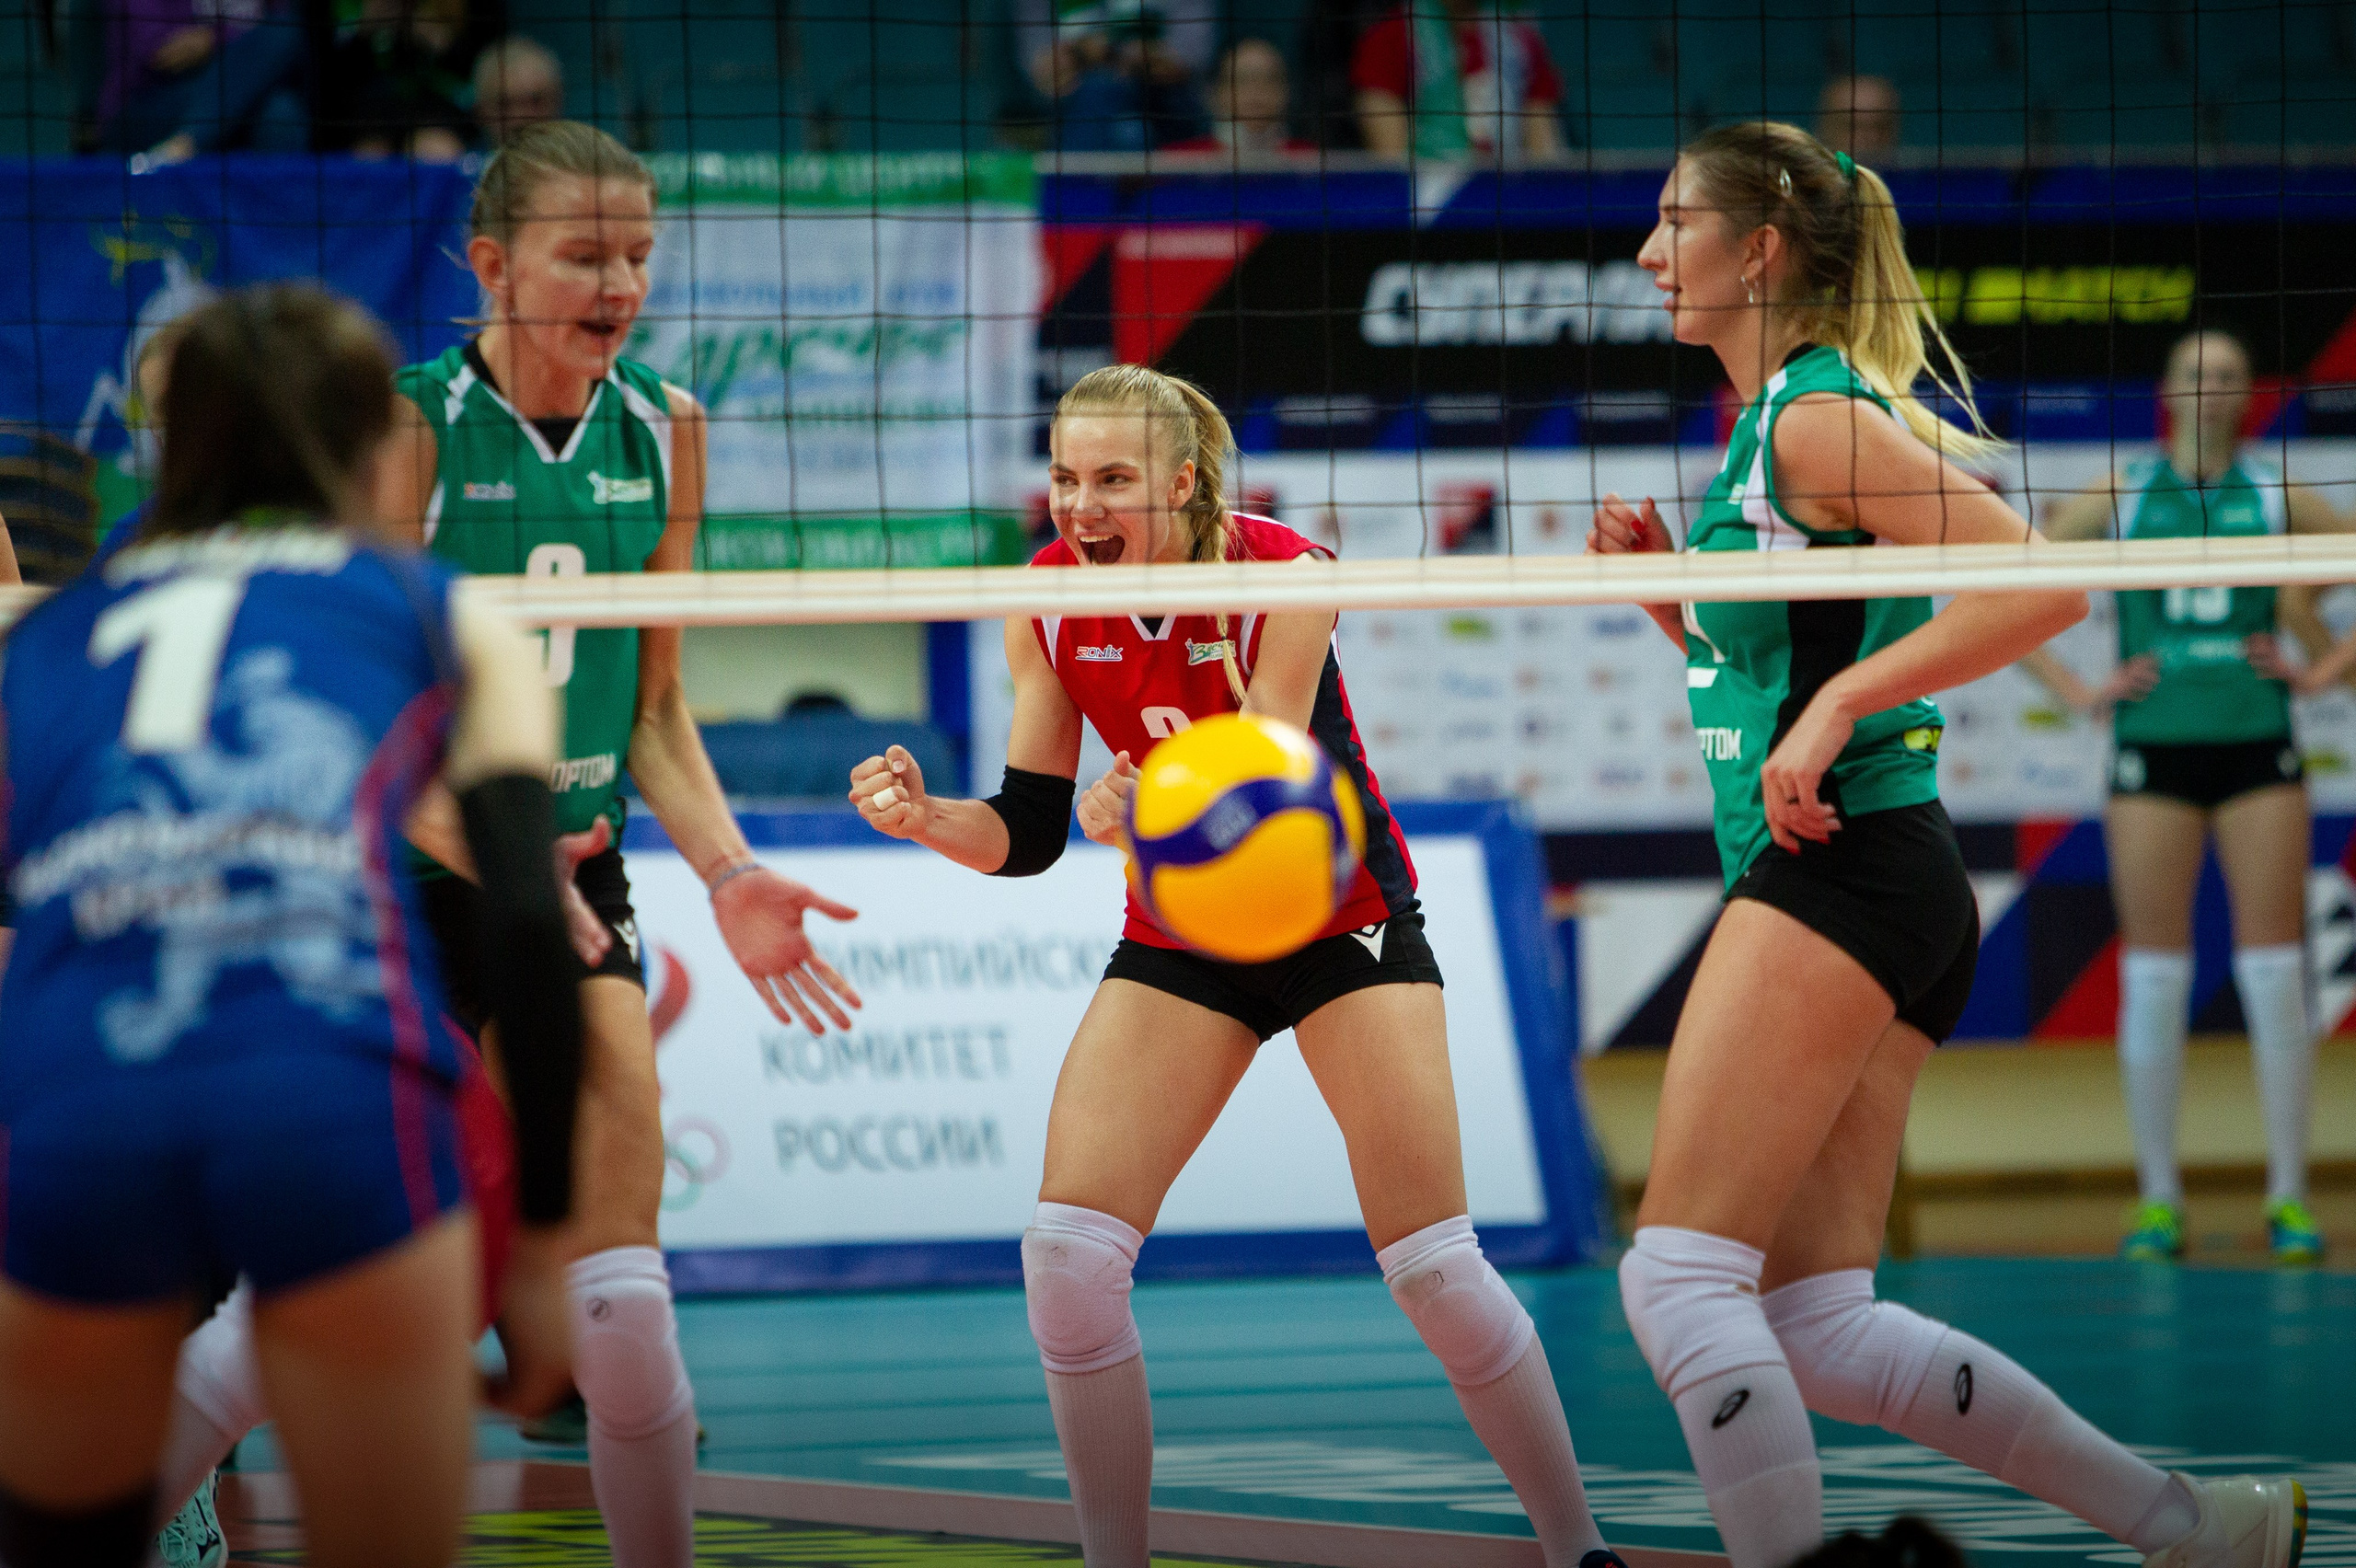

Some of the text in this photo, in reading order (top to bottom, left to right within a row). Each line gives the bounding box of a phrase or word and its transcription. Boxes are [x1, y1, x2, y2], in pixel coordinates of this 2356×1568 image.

[90, 576, 245, 753] 1
[1076, 645, 1123, 660] RONIX
[551, 751, 617, 793] ОРТОМ
[758, 1025, 1011, 1087] КОМИТЕТ
[771, 1113, 1008, 1176] РОССИИ
